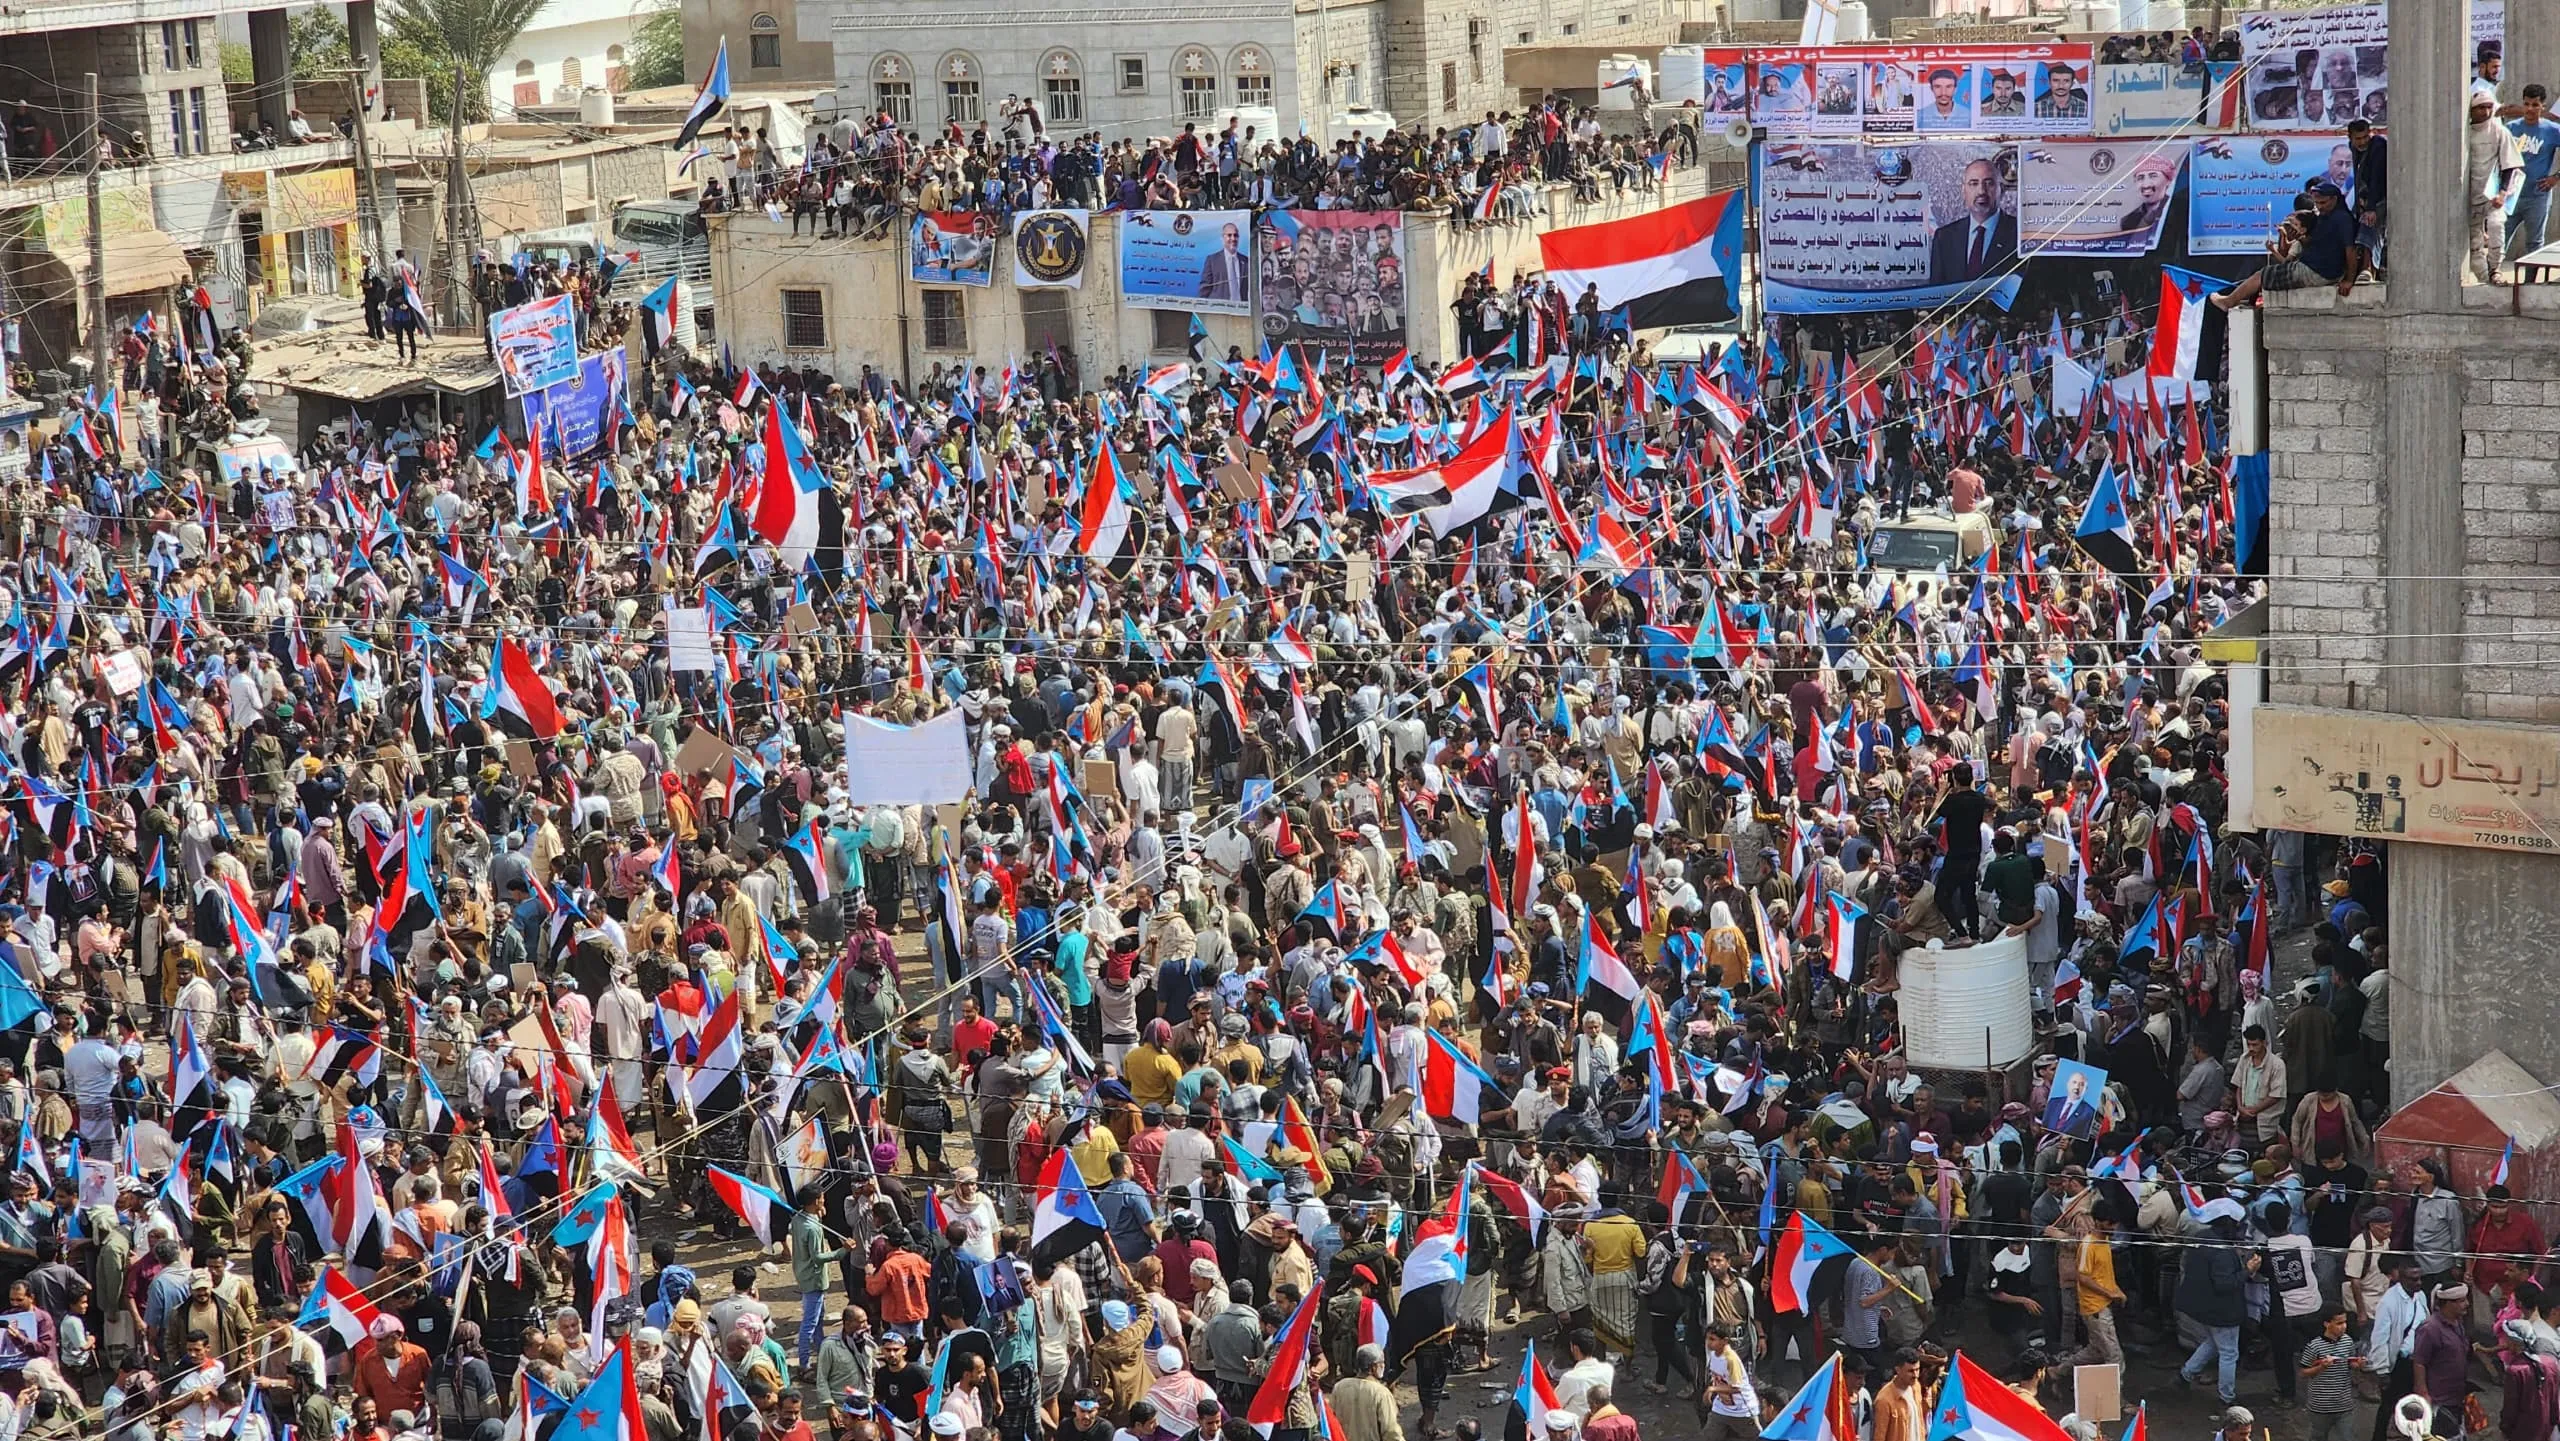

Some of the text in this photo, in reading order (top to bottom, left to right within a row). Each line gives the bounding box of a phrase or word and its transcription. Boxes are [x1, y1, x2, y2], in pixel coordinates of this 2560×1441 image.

[1770, 185, 1832, 201] الثورة
[1769, 205, 1827, 228] والتصدي
[1831, 206, 1879, 226] الصمود
[1767, 230, 1928, 253] المجلس الانتقالي الجنوبي يمثلنا
[1839, 258, 1880, 274] عيدروس
[1883, 256, 1926, 275] والرئيس
[2474, 831, 2553, 849] 770916388
